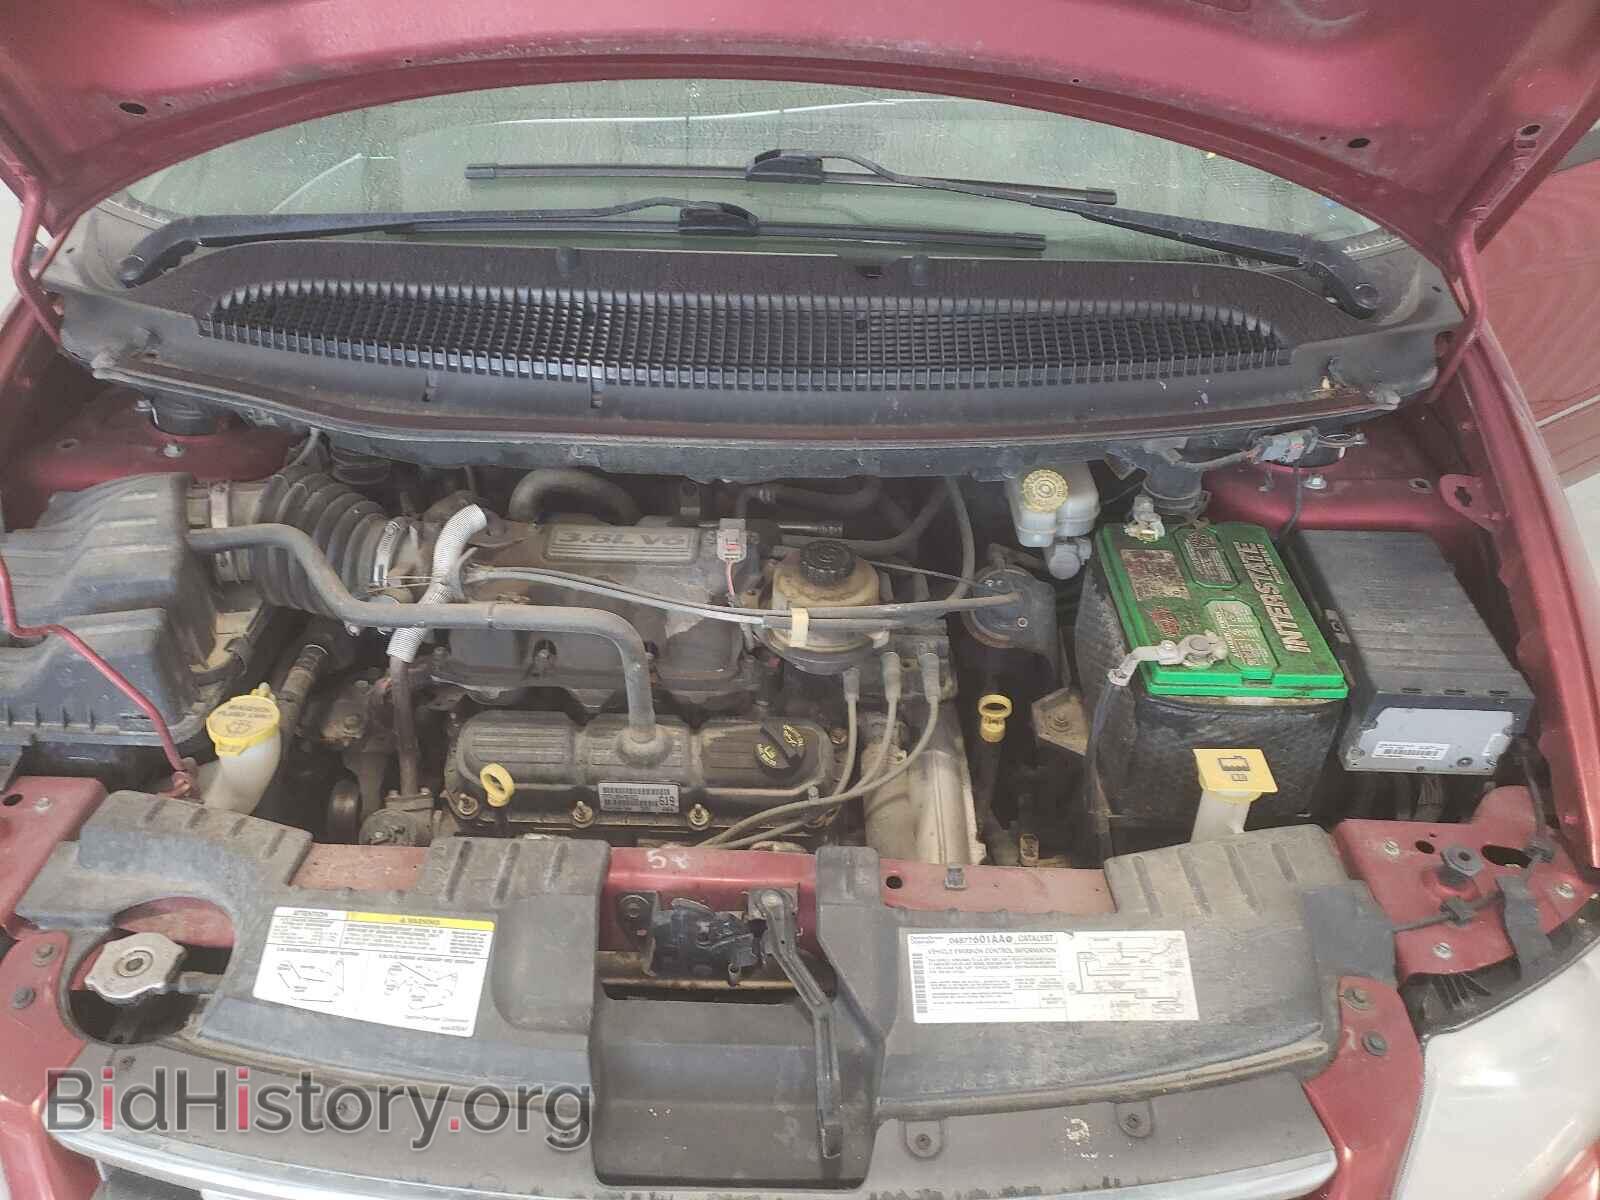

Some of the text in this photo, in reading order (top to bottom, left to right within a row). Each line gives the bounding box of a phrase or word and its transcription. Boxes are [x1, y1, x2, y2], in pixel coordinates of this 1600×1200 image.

[1232, 541, 1312, 653] INTERSTATE
[1017, 934, 1054, 943] CATALYST
[985, 947, 1014, 955] CONTROL
